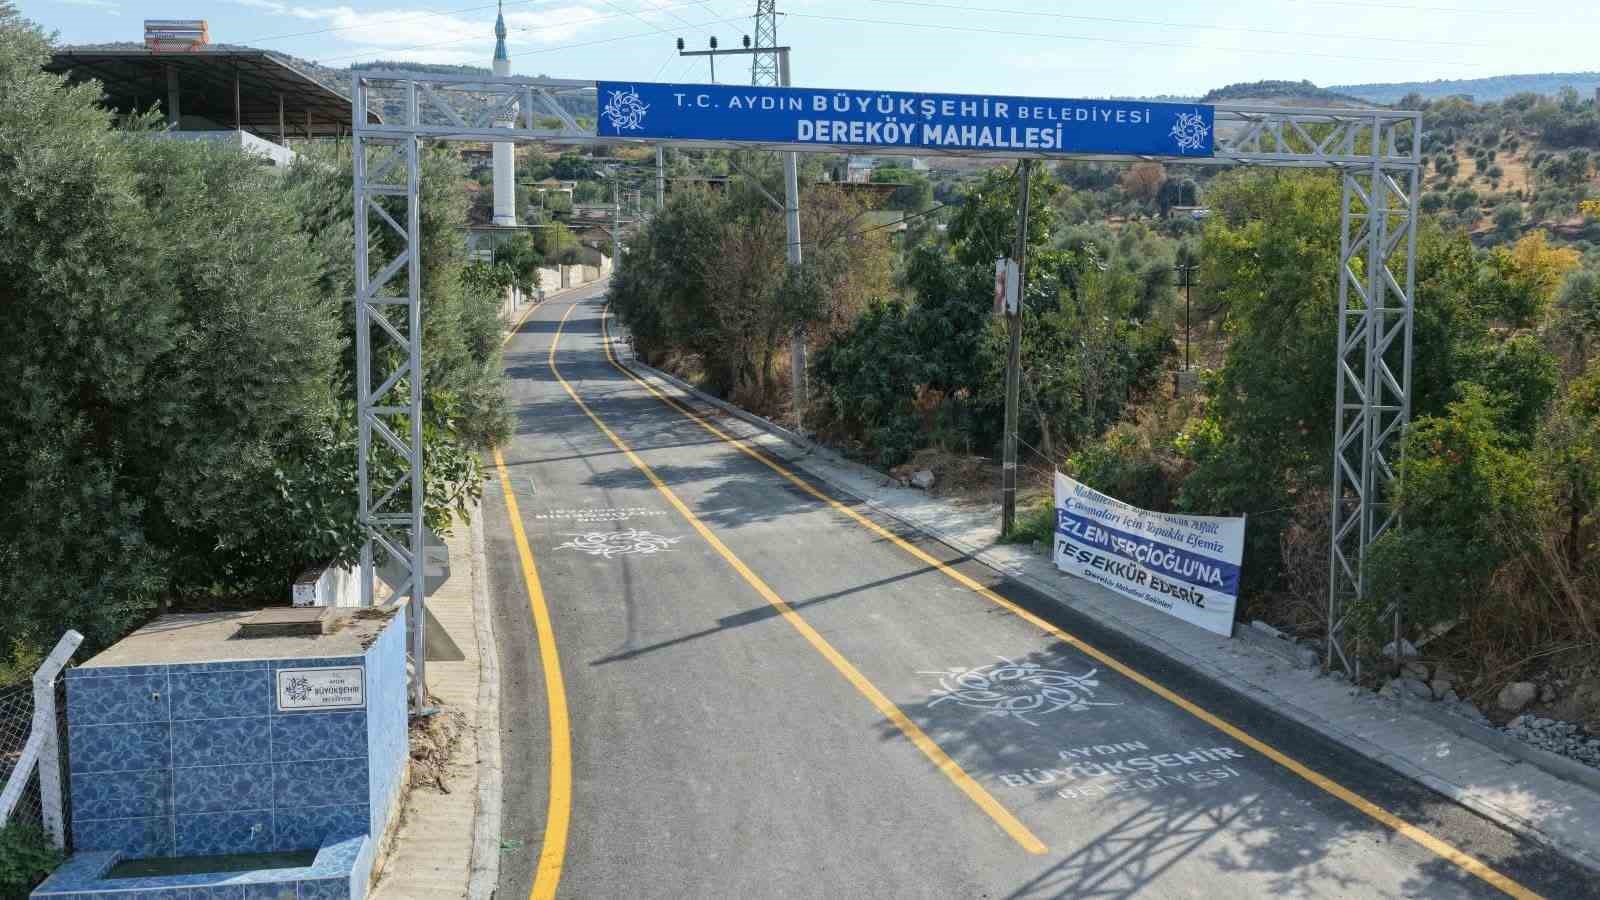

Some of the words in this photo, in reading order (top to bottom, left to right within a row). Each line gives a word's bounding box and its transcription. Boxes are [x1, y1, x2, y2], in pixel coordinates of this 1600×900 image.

[673, 93, 719, 109] T.C.
[728, 95, 804, 111] AYDIN
[812, 92, 1009, 120] BÜYÜKŞEHİR
[1018, 106, 1150, 124] BELEDİYESİ
[797, 117, 917, 145] DEREKÖY
[922, 122, 1063, 149] MAHALLESİ
[1057, 540, 1147, 586] TEŞEKKÜR
[1149, 575, 1205, 609] EDERİZ
[1057, 740, 1149, 760] AYDIN
